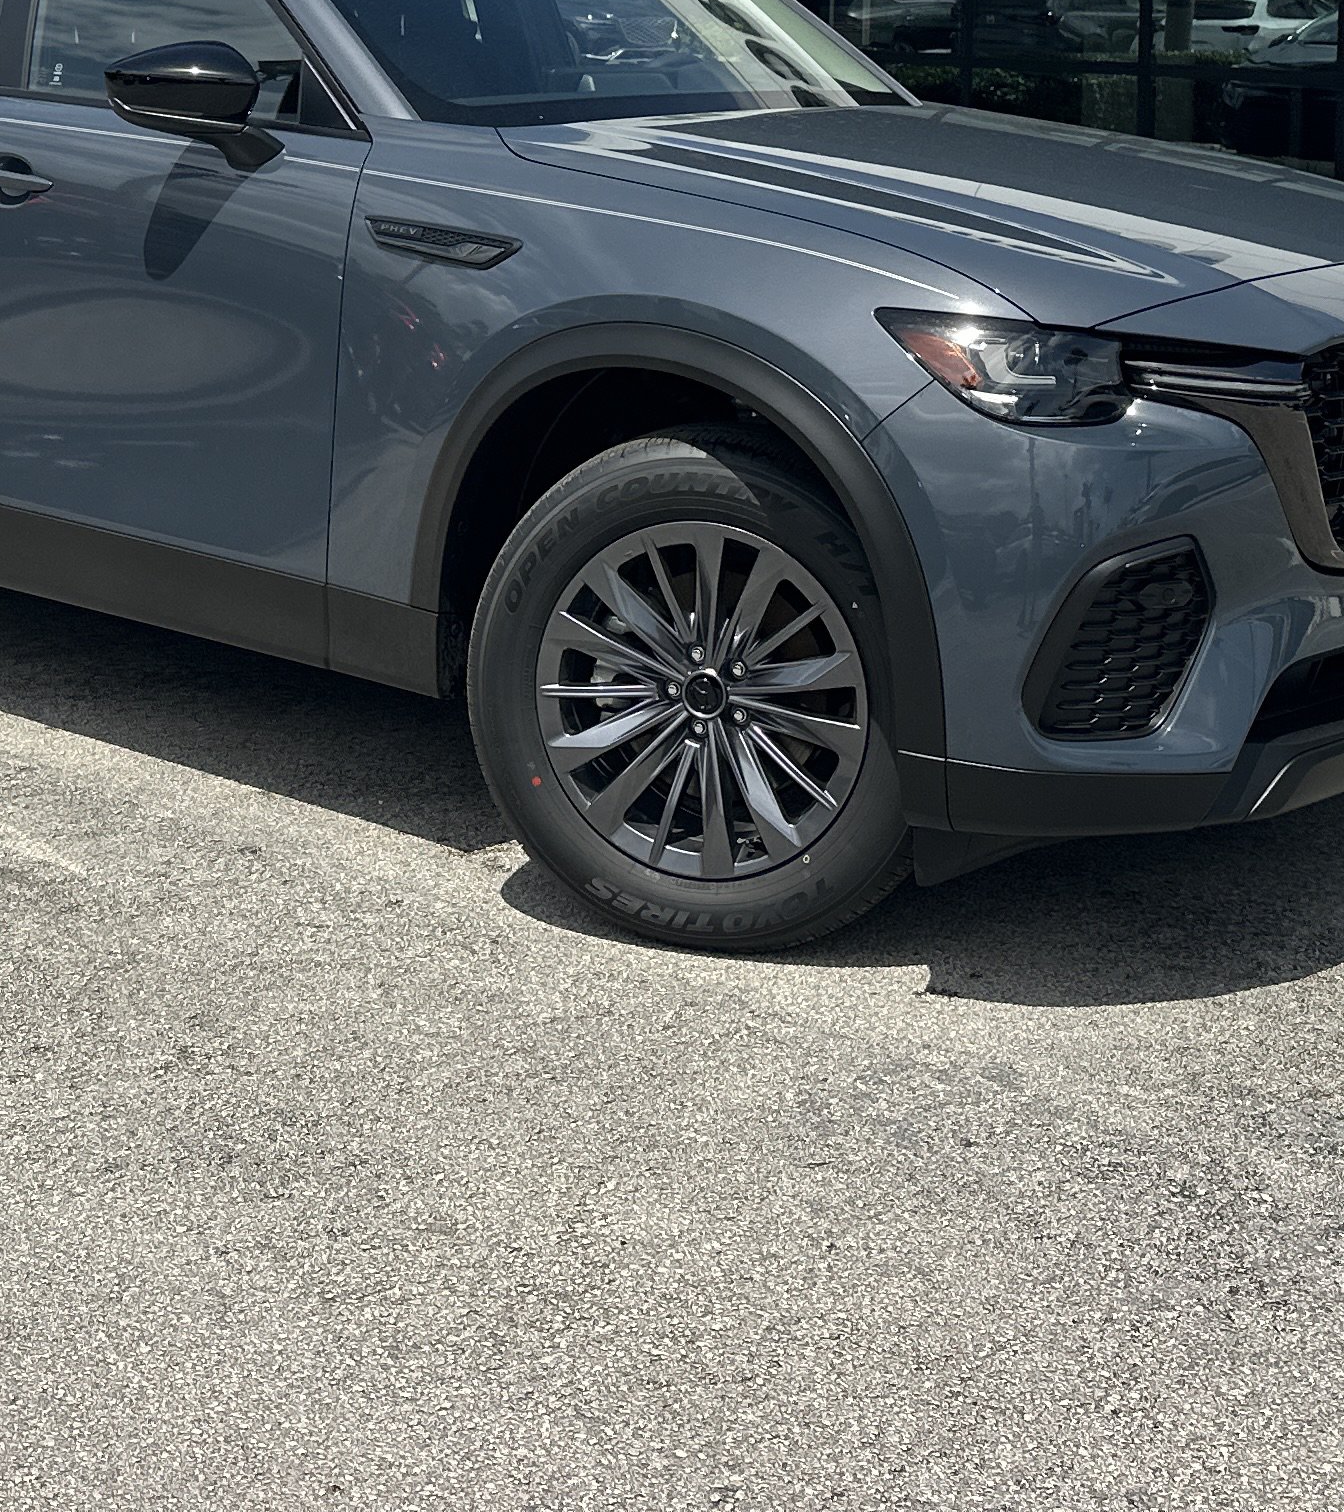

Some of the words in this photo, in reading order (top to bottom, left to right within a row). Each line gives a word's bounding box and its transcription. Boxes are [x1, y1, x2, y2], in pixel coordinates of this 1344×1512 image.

[380, 223, 418, 235] PHEV
[504, 508, 581, 614] OPEN
[595, 471, 801, 513] COUNTRY
[583, 876, 718, 933] TIRES
[722, 877, 834, 934] TOYO
